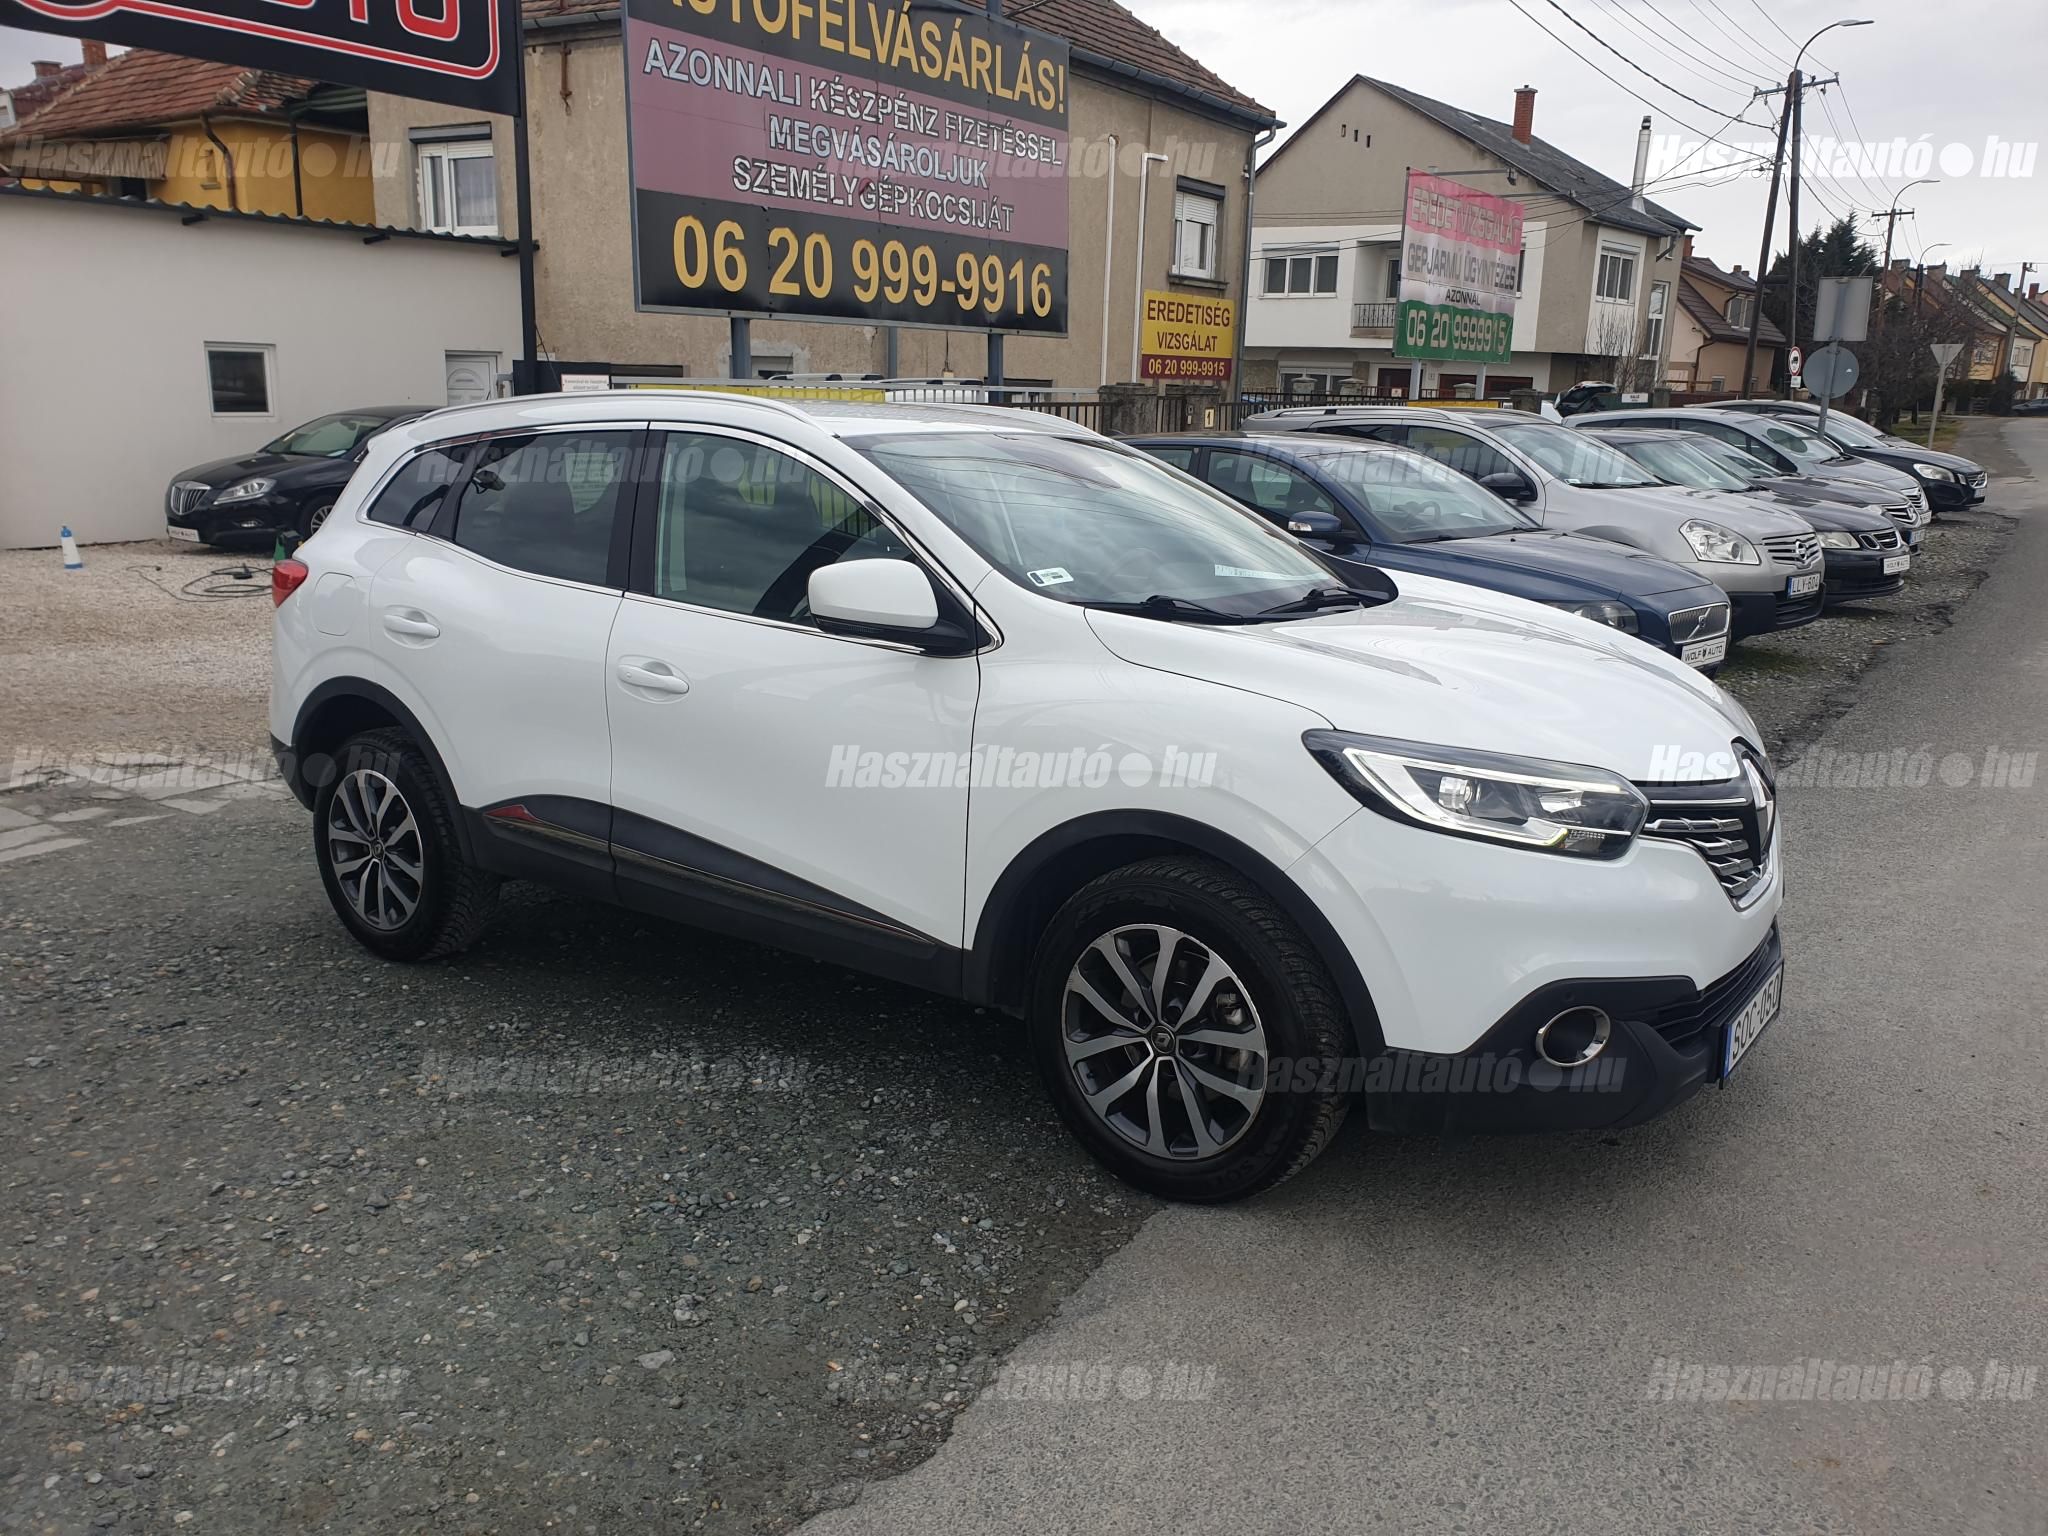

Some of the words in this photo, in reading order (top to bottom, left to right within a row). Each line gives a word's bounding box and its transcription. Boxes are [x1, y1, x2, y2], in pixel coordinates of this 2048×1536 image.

[672, 0, 1064, 114] FELVÁSÁRLÁS!
[643, 37, 801, 106] AZONNALI
[810, 73, 939, 138] KÉSZPÉNZ
[944, 111, 1062, 166] FIZETÉSSEL
[769, 115, 988, 189] MEGVÁSÁROLJUK
[673, 215, 748, 292] 06
[768, 227, 833, 299] 20
[852, 239, 1052, 318] 999-9916
[1147, 299, 1230, 327] EREDETISÉG
[1445, 288, 1480, 306] AZONNAL
[1157, 330, 1217, 352] VIZSGÁLAT
[1406, 309, 1427, 347] 06
[1430, 311, 1449, 348] 20
[1148, 358, 1162, 374] 06
[1164, 359, 1177, 375] 20
[1180, 360, 1225, 377] 999-9915
[1684, 649, 1702, 661] WOLF
[1707, 644, 1723, 656] AUTO
